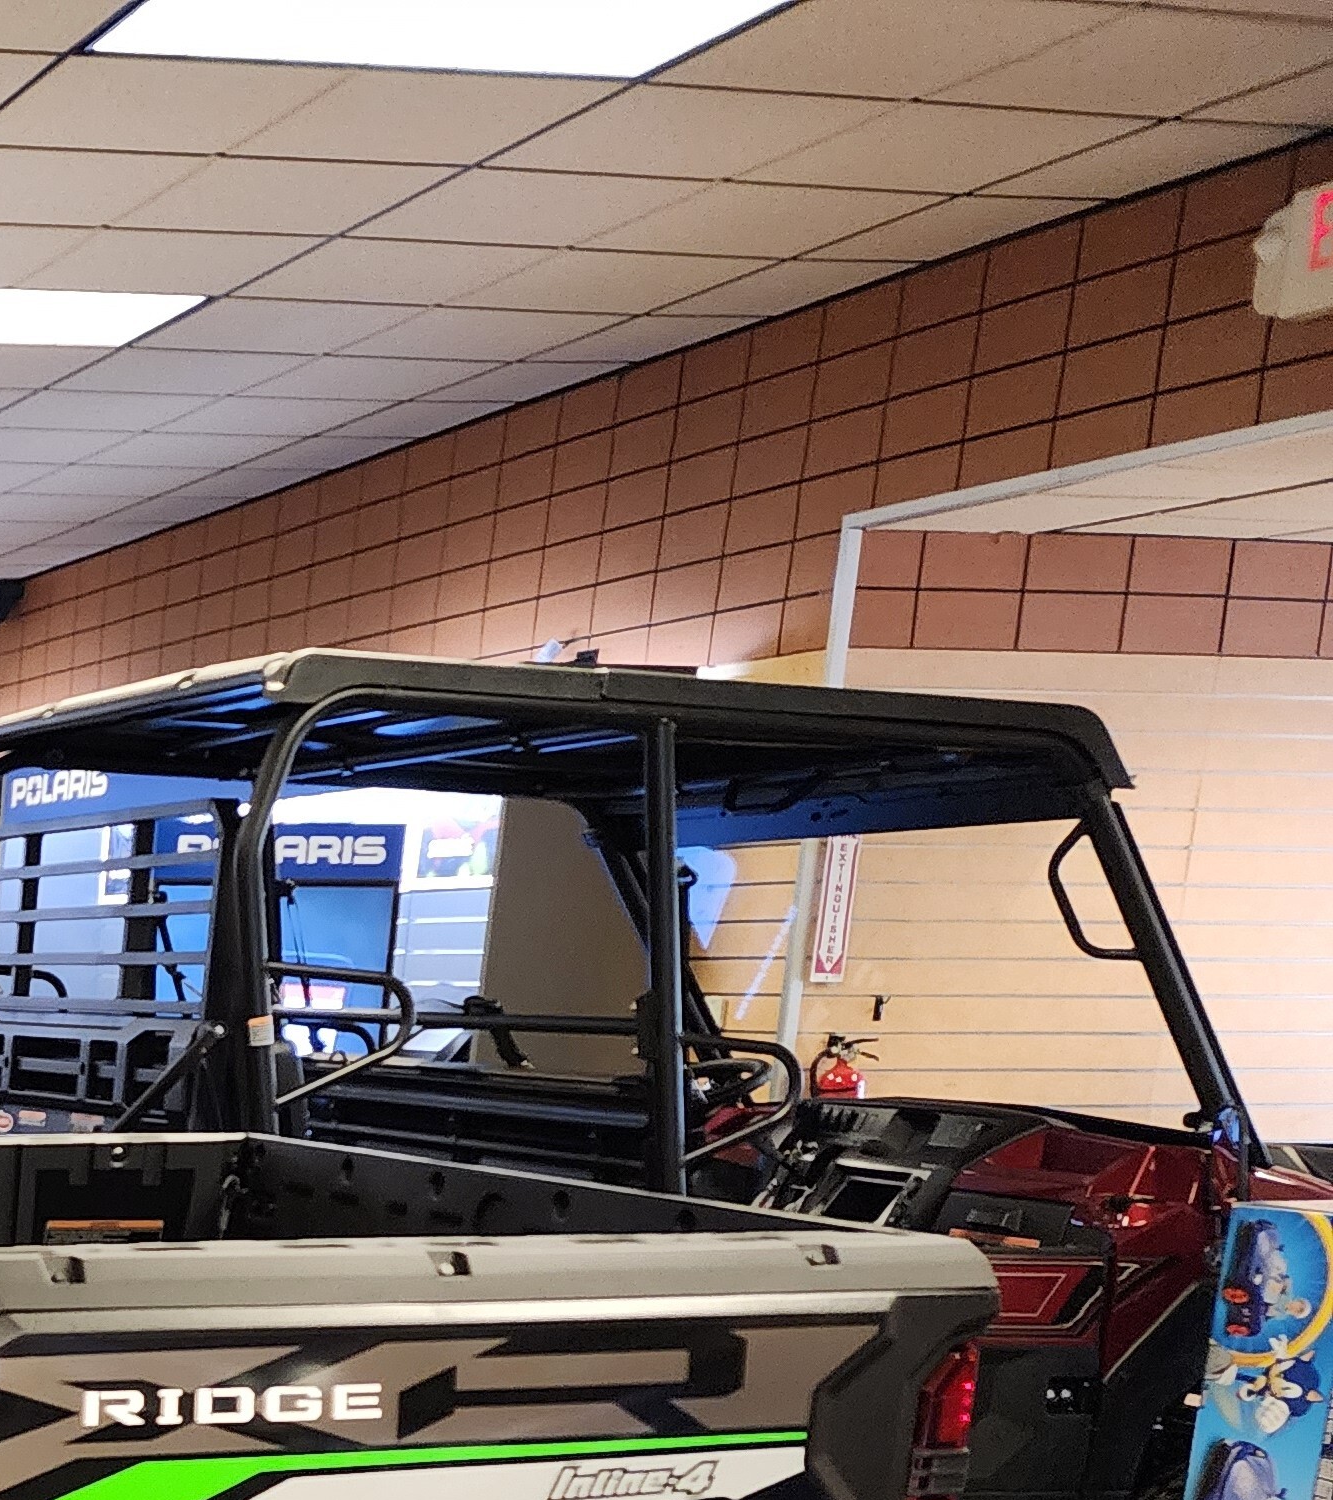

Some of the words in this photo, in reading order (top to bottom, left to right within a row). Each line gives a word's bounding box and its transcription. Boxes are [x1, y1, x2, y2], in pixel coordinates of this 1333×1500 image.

[10, 769, 109, 809] POLARIS
[177, 835, 387, 865] PARIS
[81, 1382, 383, 1427] RIDGE
